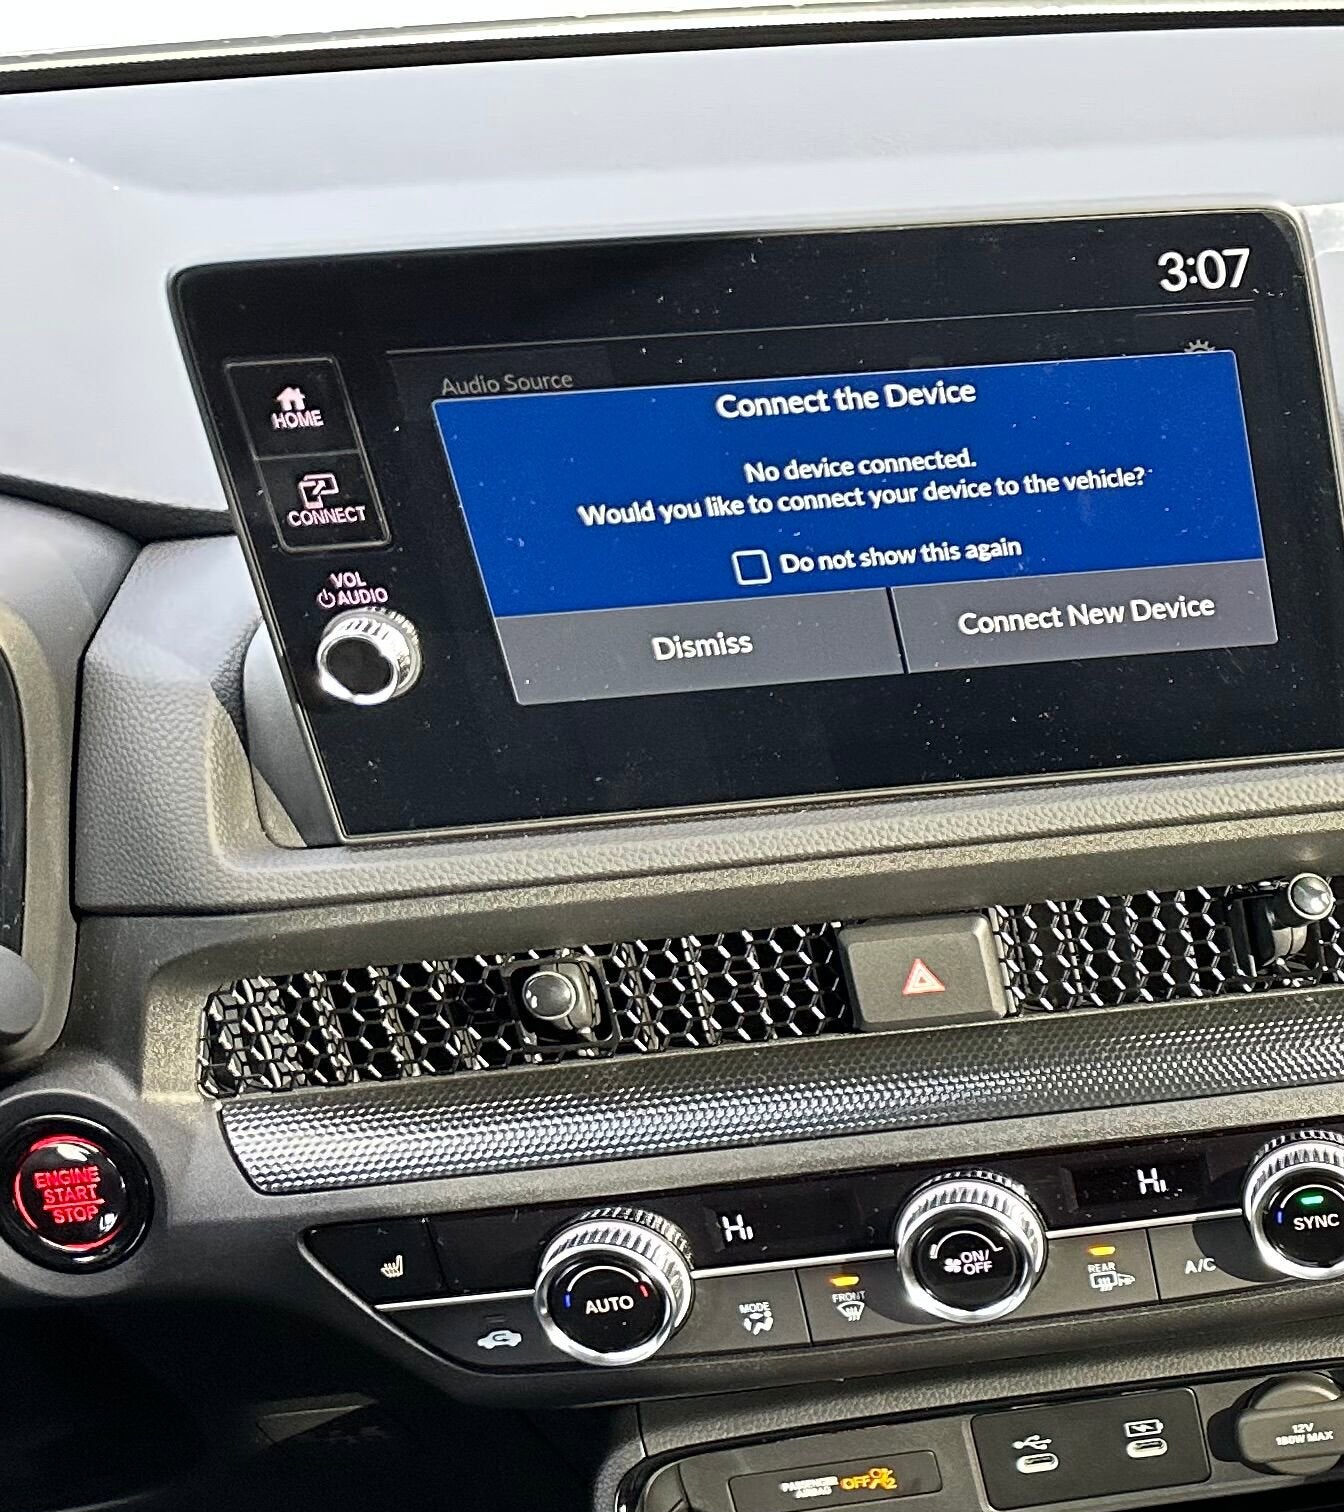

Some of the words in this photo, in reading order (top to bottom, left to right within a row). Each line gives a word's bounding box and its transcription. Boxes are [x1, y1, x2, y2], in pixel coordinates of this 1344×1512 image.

[1157, 248, 1251, 293] 3:07
[441, 376, 500, 397] Audio
[504, 372, 574, 393] Source
[716, 389, 831, 419] Connect
[833, 387, 879, 410] the
[884, 380, 976, 408] Device
[272, 410, 324, 430] HOME
[743, 462, 779, 484] No
[784, 457, 854, 480] device
[858, 447, 977, 475] connected.
[577, 500, 656, 526] Would
[658, 498, 702, 525] you
[705, 495, 744, 517] like
[748, 495, 772, 514] to
[777, 487, 865, 512] connect
[868, 486, 918, 509] your
[923, 478, 992, 503] device
[996, 477, 1019, 496] to
[1024, 473, 1060, 493] the
[1062, 466, 1145, 491] vehicle?
[287, 506, 366, 528] CONNECT
[779, 553, 814, 574] Do
[817, 550, 856, 571] not
[861, 546, 917, 567] show
[920, 542, 961, 563] this
[965, 537, 1022, 564] again
[329, 571, 366, 589] VOL
[337, 588, 388, 606] AUDIO
[958, 606, 1064, 637] Connect
[1068, 602, 1125, 628] New
[1131, 595, 1215, 622] Device
[651, 631, 753, 661] Dismiss
[34, 1166, 101, 1189] ENGINE
[43, 1184, 98, 1204] START
[53, 1206, 98, 1224] STOP
[1293, 1214, 1340, 1231] SYNC
[960, 1249, 990, 1263] ON/
[963, 1260, 993, 1275] OFF
[1088, 1261, 1116, 1273] REAR
[1184, 1257, 1216, 1275] A/C
[832, 1290, 866, 1302] FRONT
[585, 1296, 634, 1315] AUTO
[739, 1301, 770, 1314] MODE
[1292, 1422, 1314, 1433] 12V
[1307, 1431, 1333, 1442] MAX
[840, 1475, 871, 1490] OFF
